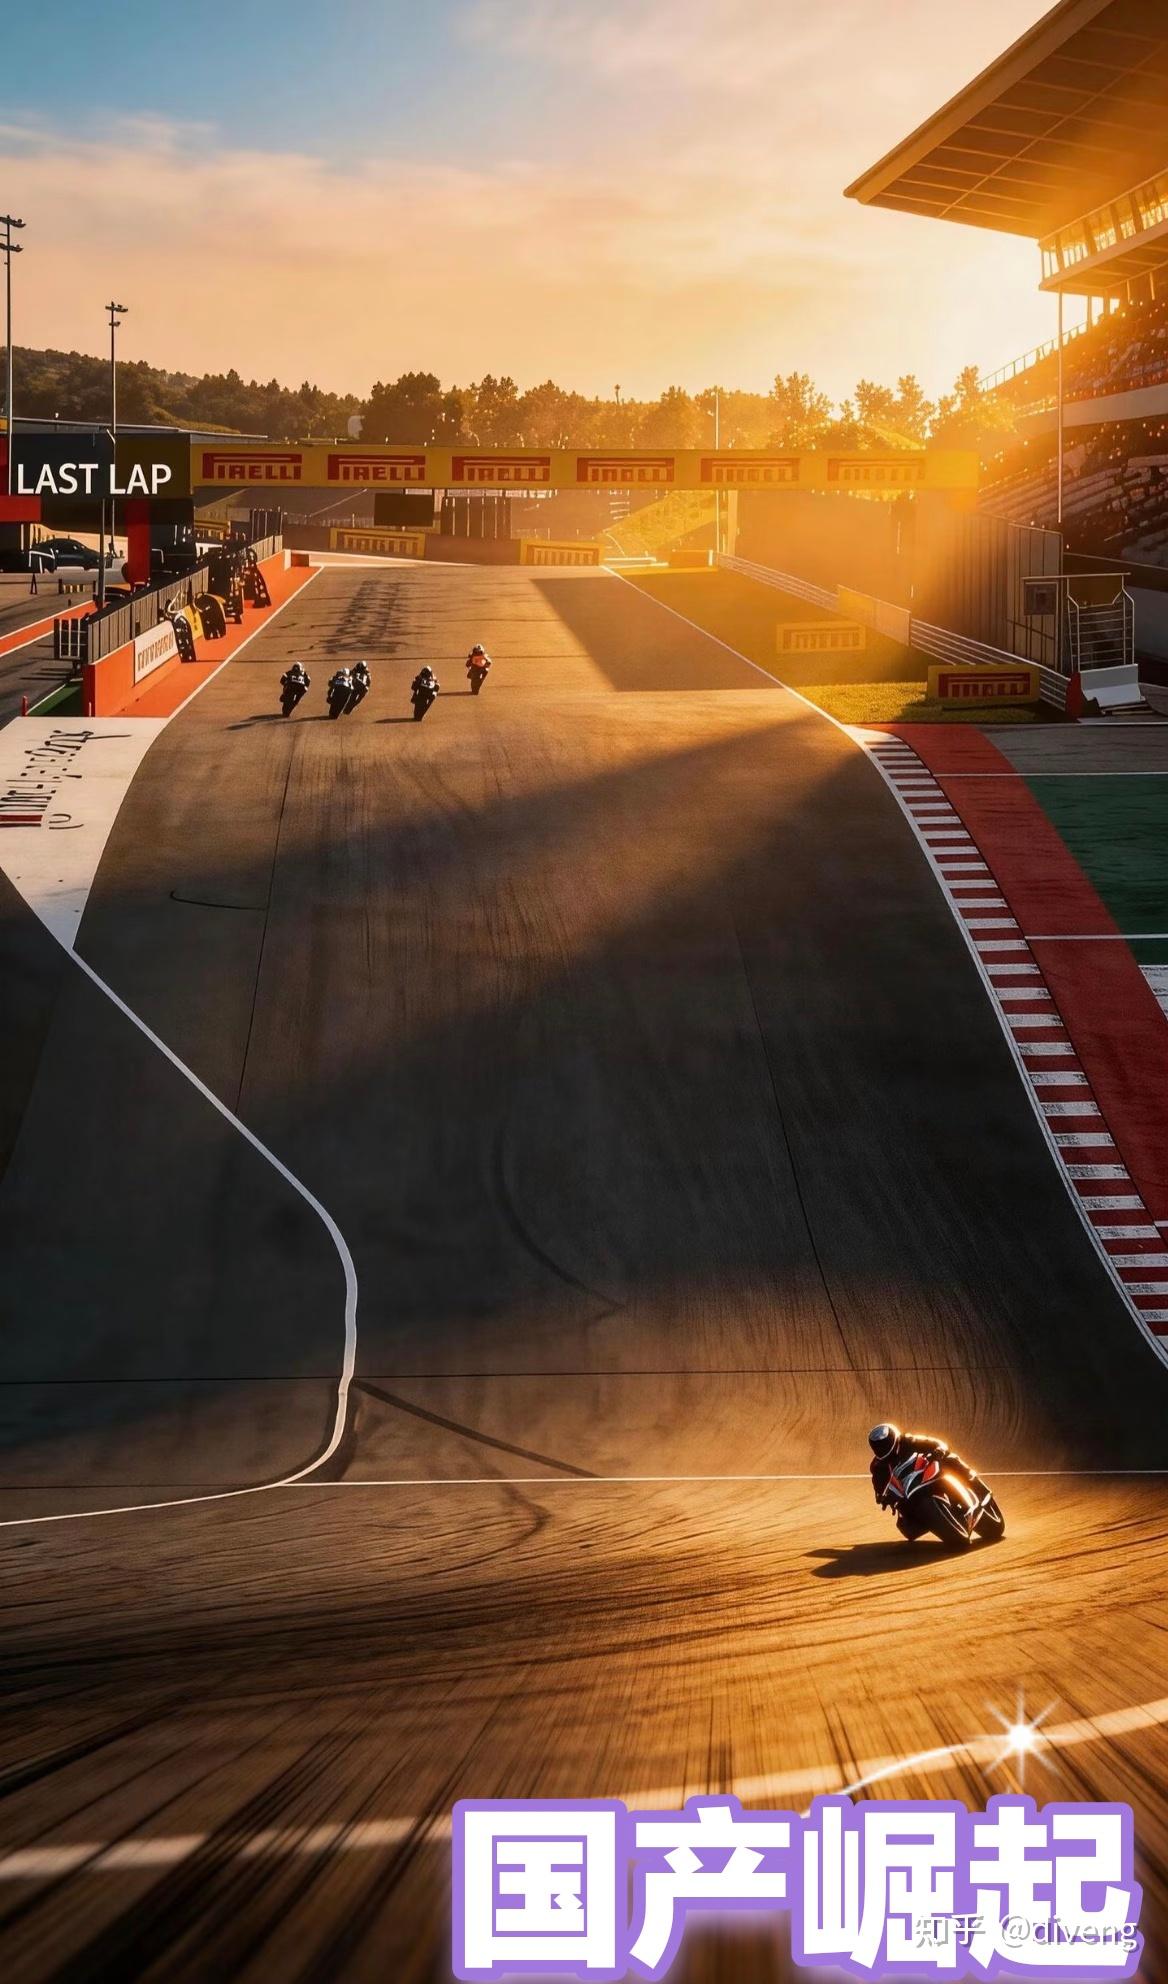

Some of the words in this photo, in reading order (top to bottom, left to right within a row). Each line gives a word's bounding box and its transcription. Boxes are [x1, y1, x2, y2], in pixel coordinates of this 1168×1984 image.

[17, 463, 99, 495] LAST
[110, 463, 172, 495] LAP
[203, 453, 302, 479] PIRELLI
[328, 454, 425, 480] PIRELLI
